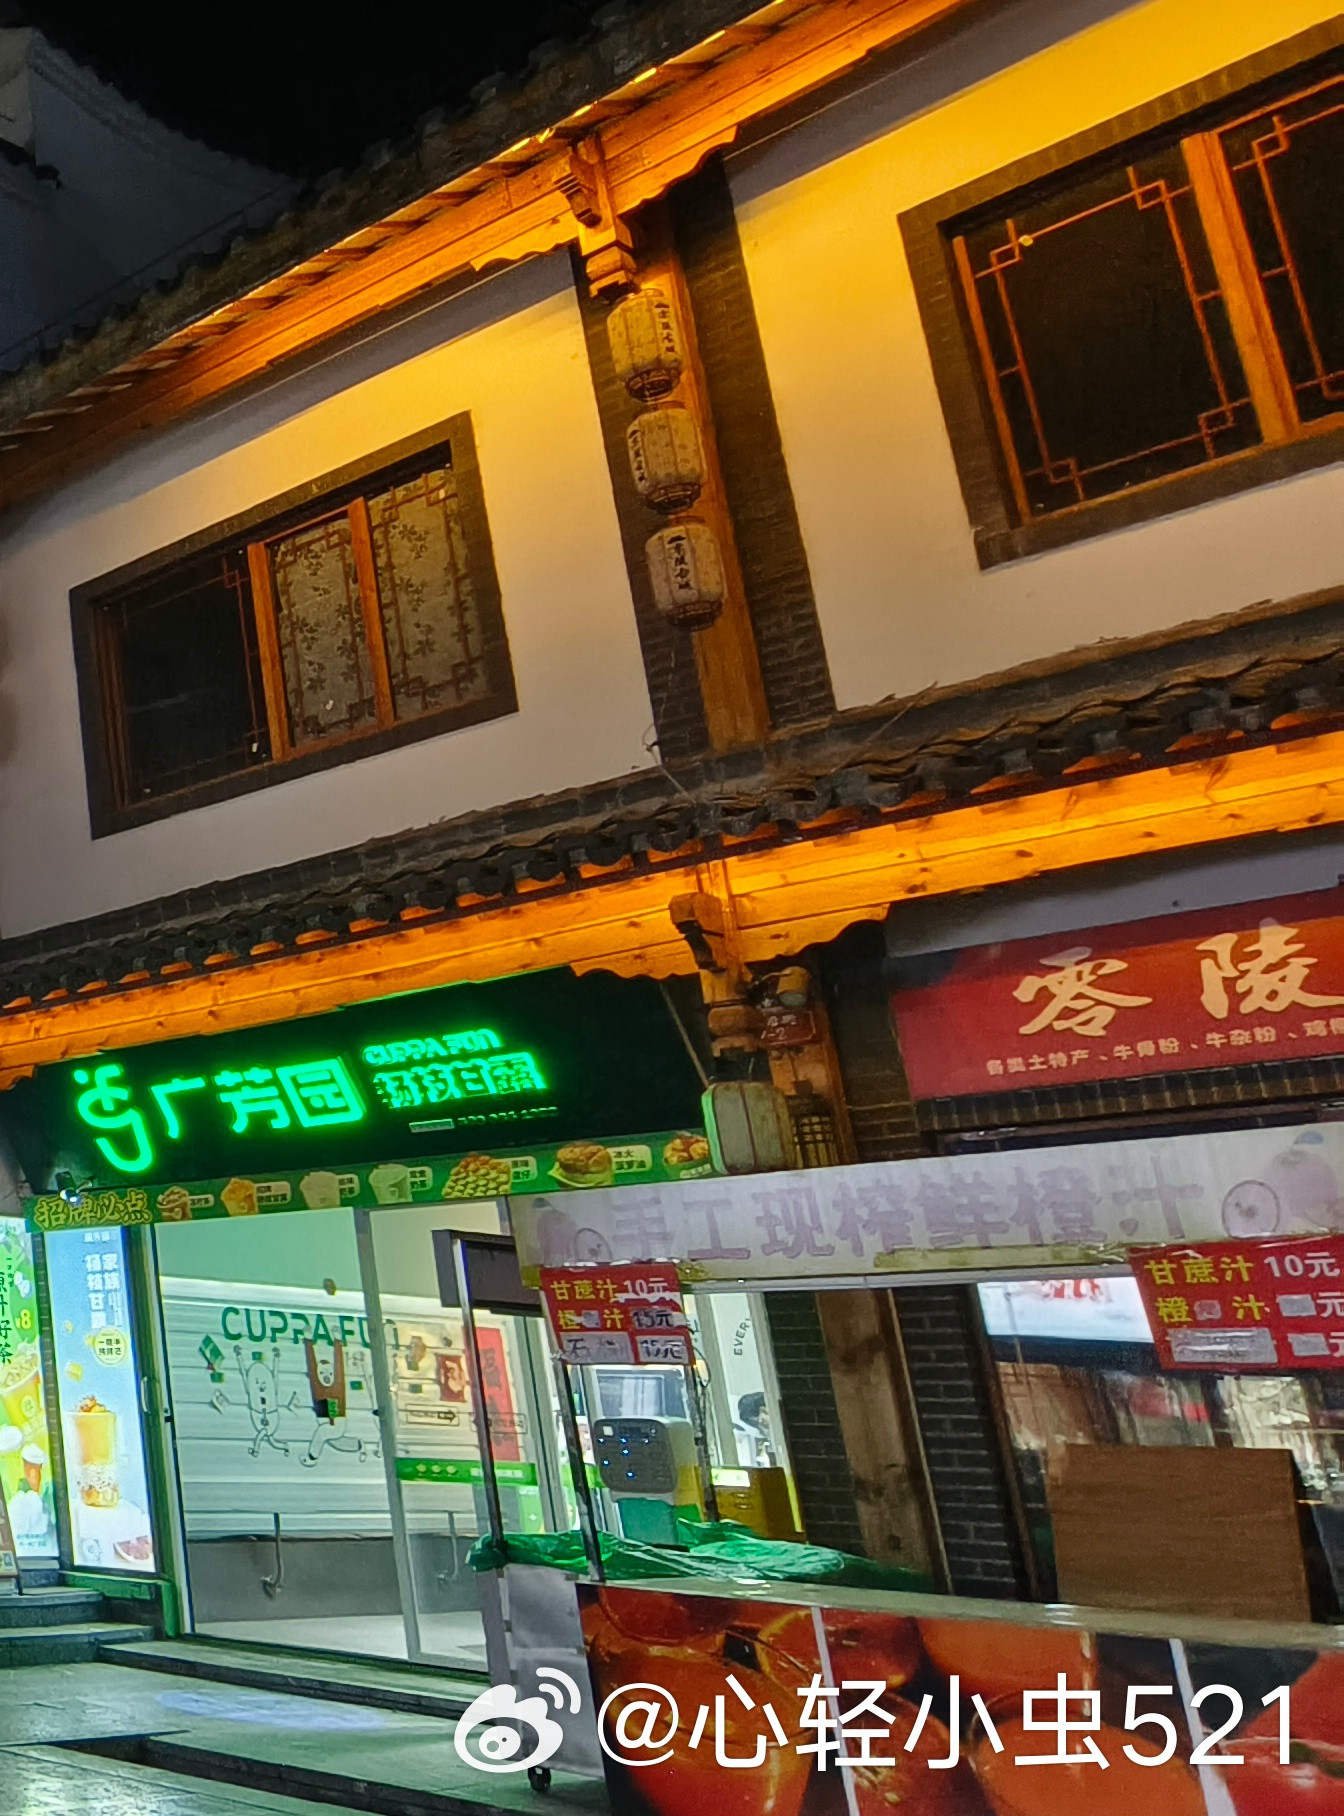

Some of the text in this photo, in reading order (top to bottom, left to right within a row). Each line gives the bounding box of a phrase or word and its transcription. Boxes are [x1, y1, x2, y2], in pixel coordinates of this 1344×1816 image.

[1013, 918, 1344, 1037] 零陵
[148, 1057, 365, 1140] 广芳园
[550, 1278, 618, 1301] 甘蔗汁
[1144, 1252, 1341, 1285] 甘蔗汁 10元
